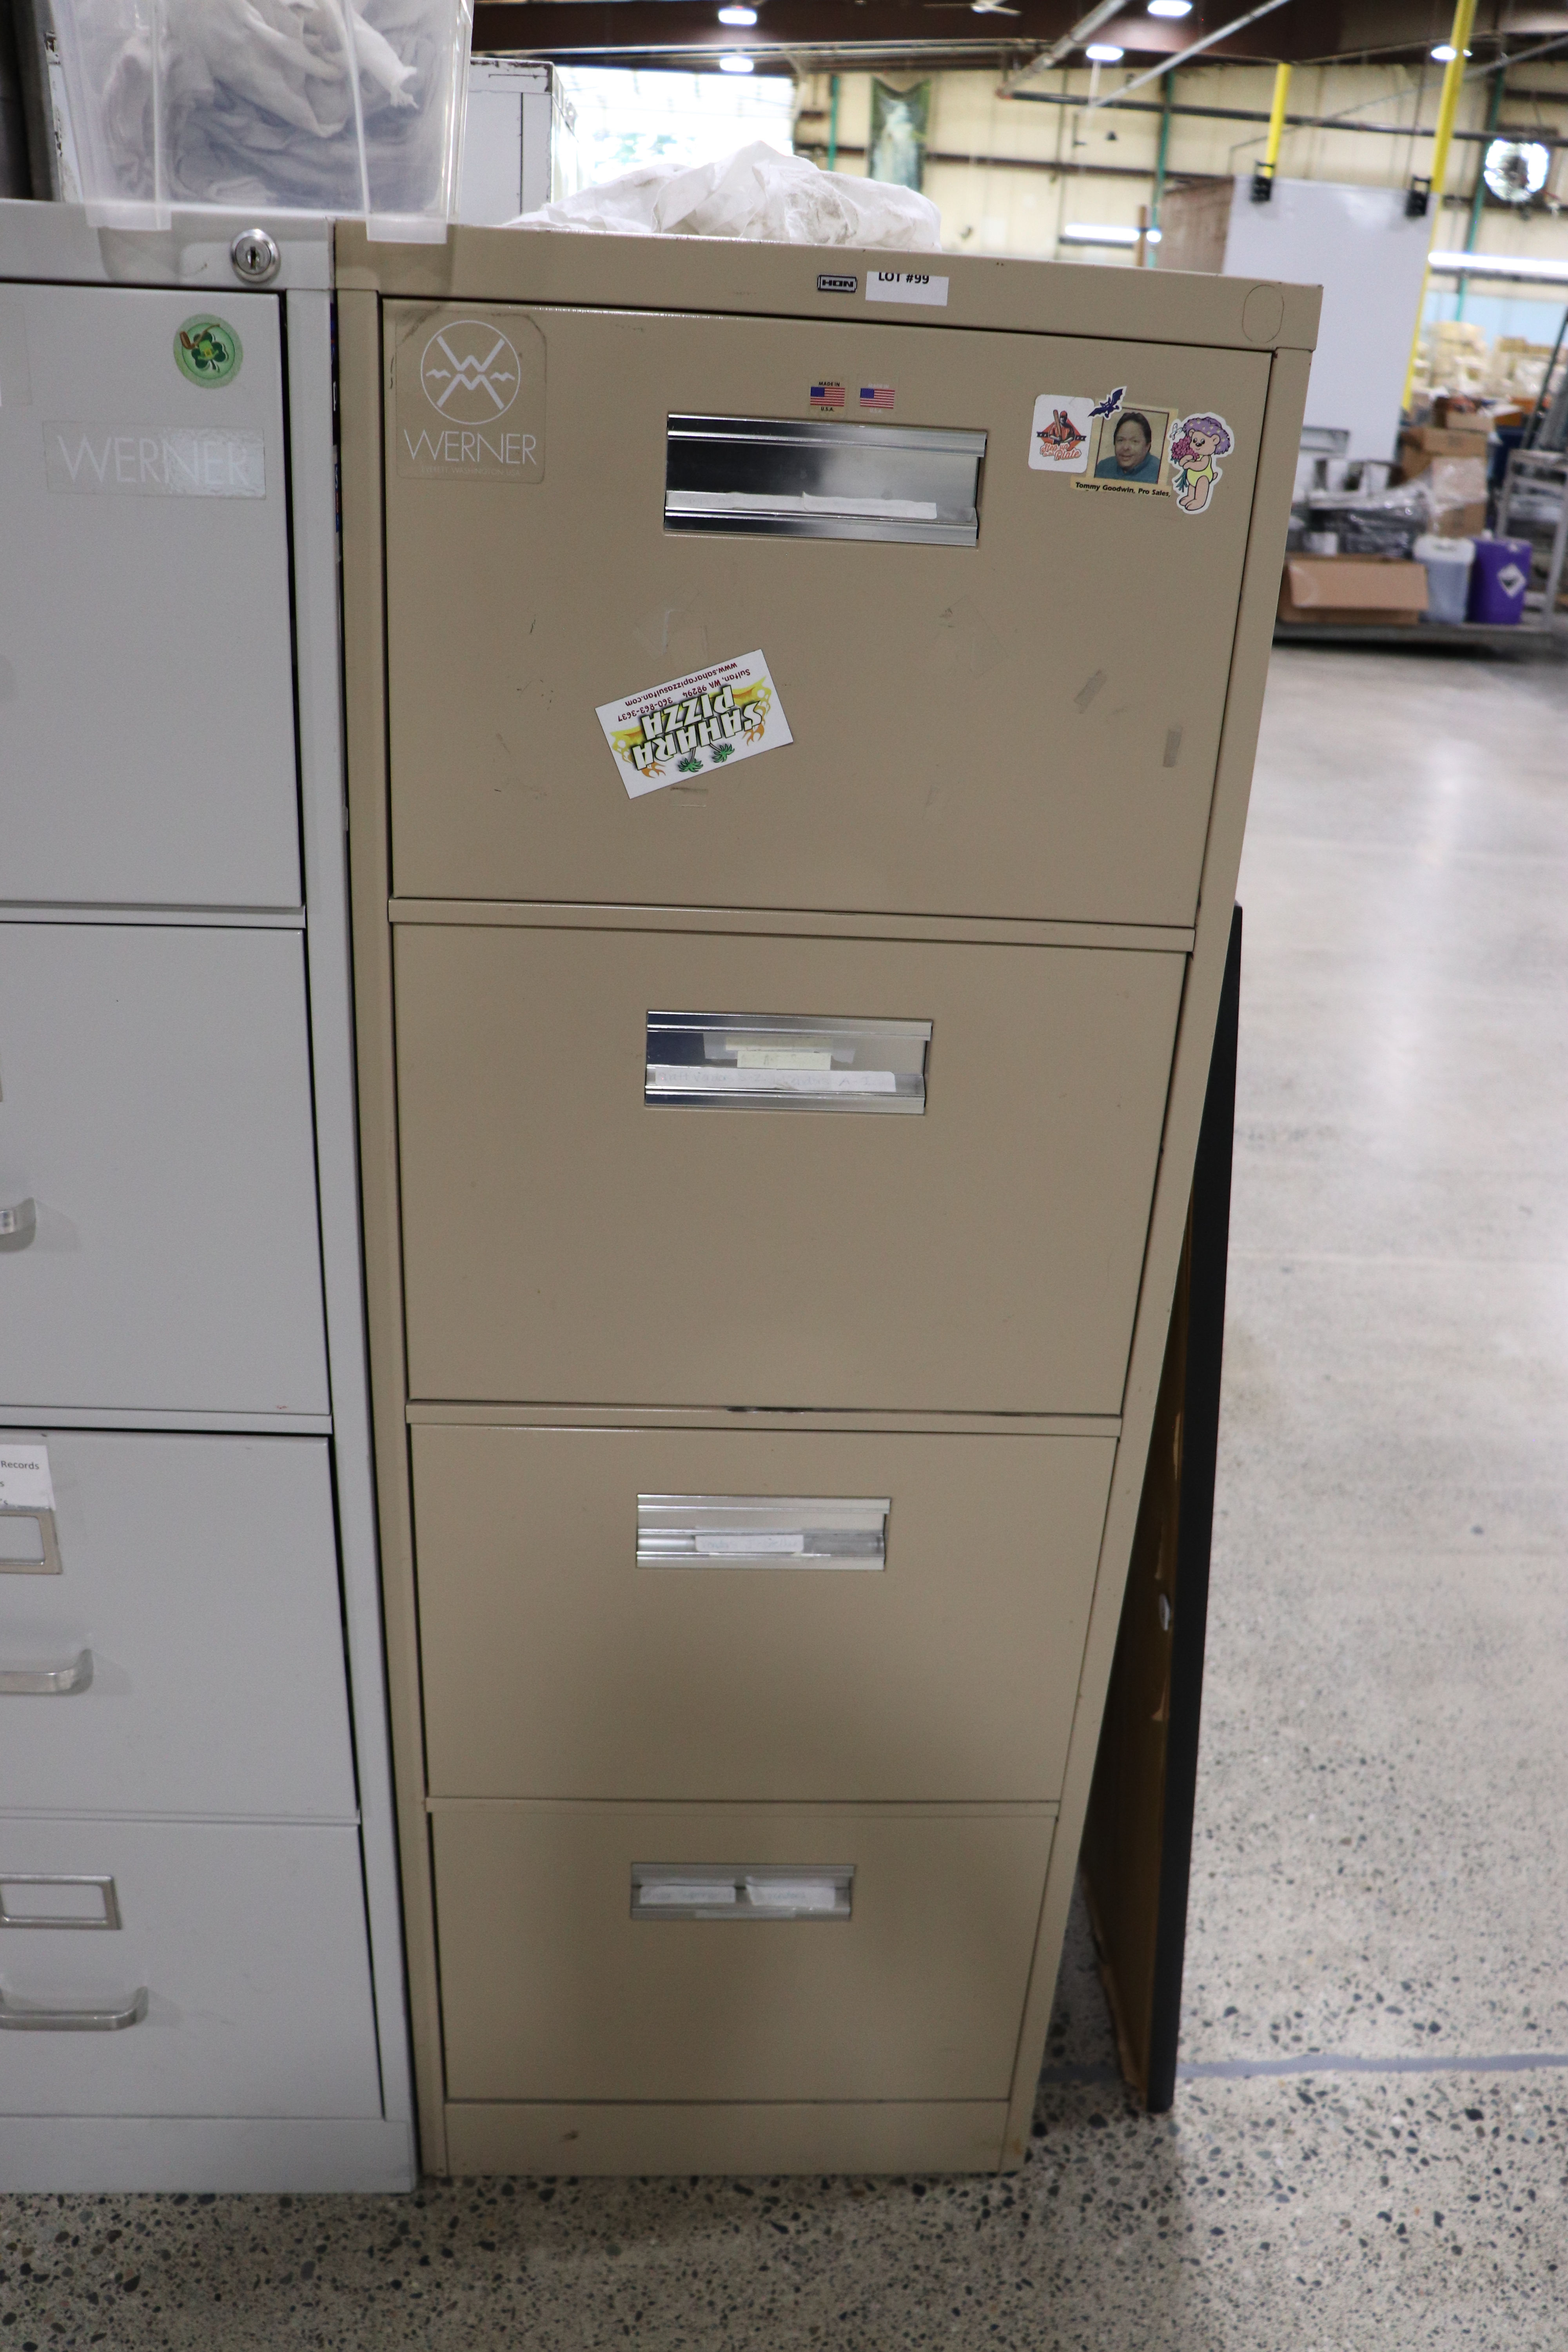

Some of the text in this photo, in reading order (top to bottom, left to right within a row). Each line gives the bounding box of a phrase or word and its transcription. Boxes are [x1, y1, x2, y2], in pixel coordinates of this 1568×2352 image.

[822, 279, 854, 288] HON
[878, 272, 929, 284] LOT #99
[57, 433, 250, 486] WERNER
[404, 429, 537, 465] WERNER
[1054, 448, 1080, 460] Plate
[1075, 483, 1100, 491] Tommy
[1103, 485, 1135, 494] Goodwin,
[618, 669, 750, 722] Sultan, WA 98294 360-863-3637
[625, 662, 737, 706] www.saharapizzasultan.com
[640, 684, 735, 741] PIZZA
[631, 700, 762, 771] SAHARA
[1, 1461, 39, 1470] Records
